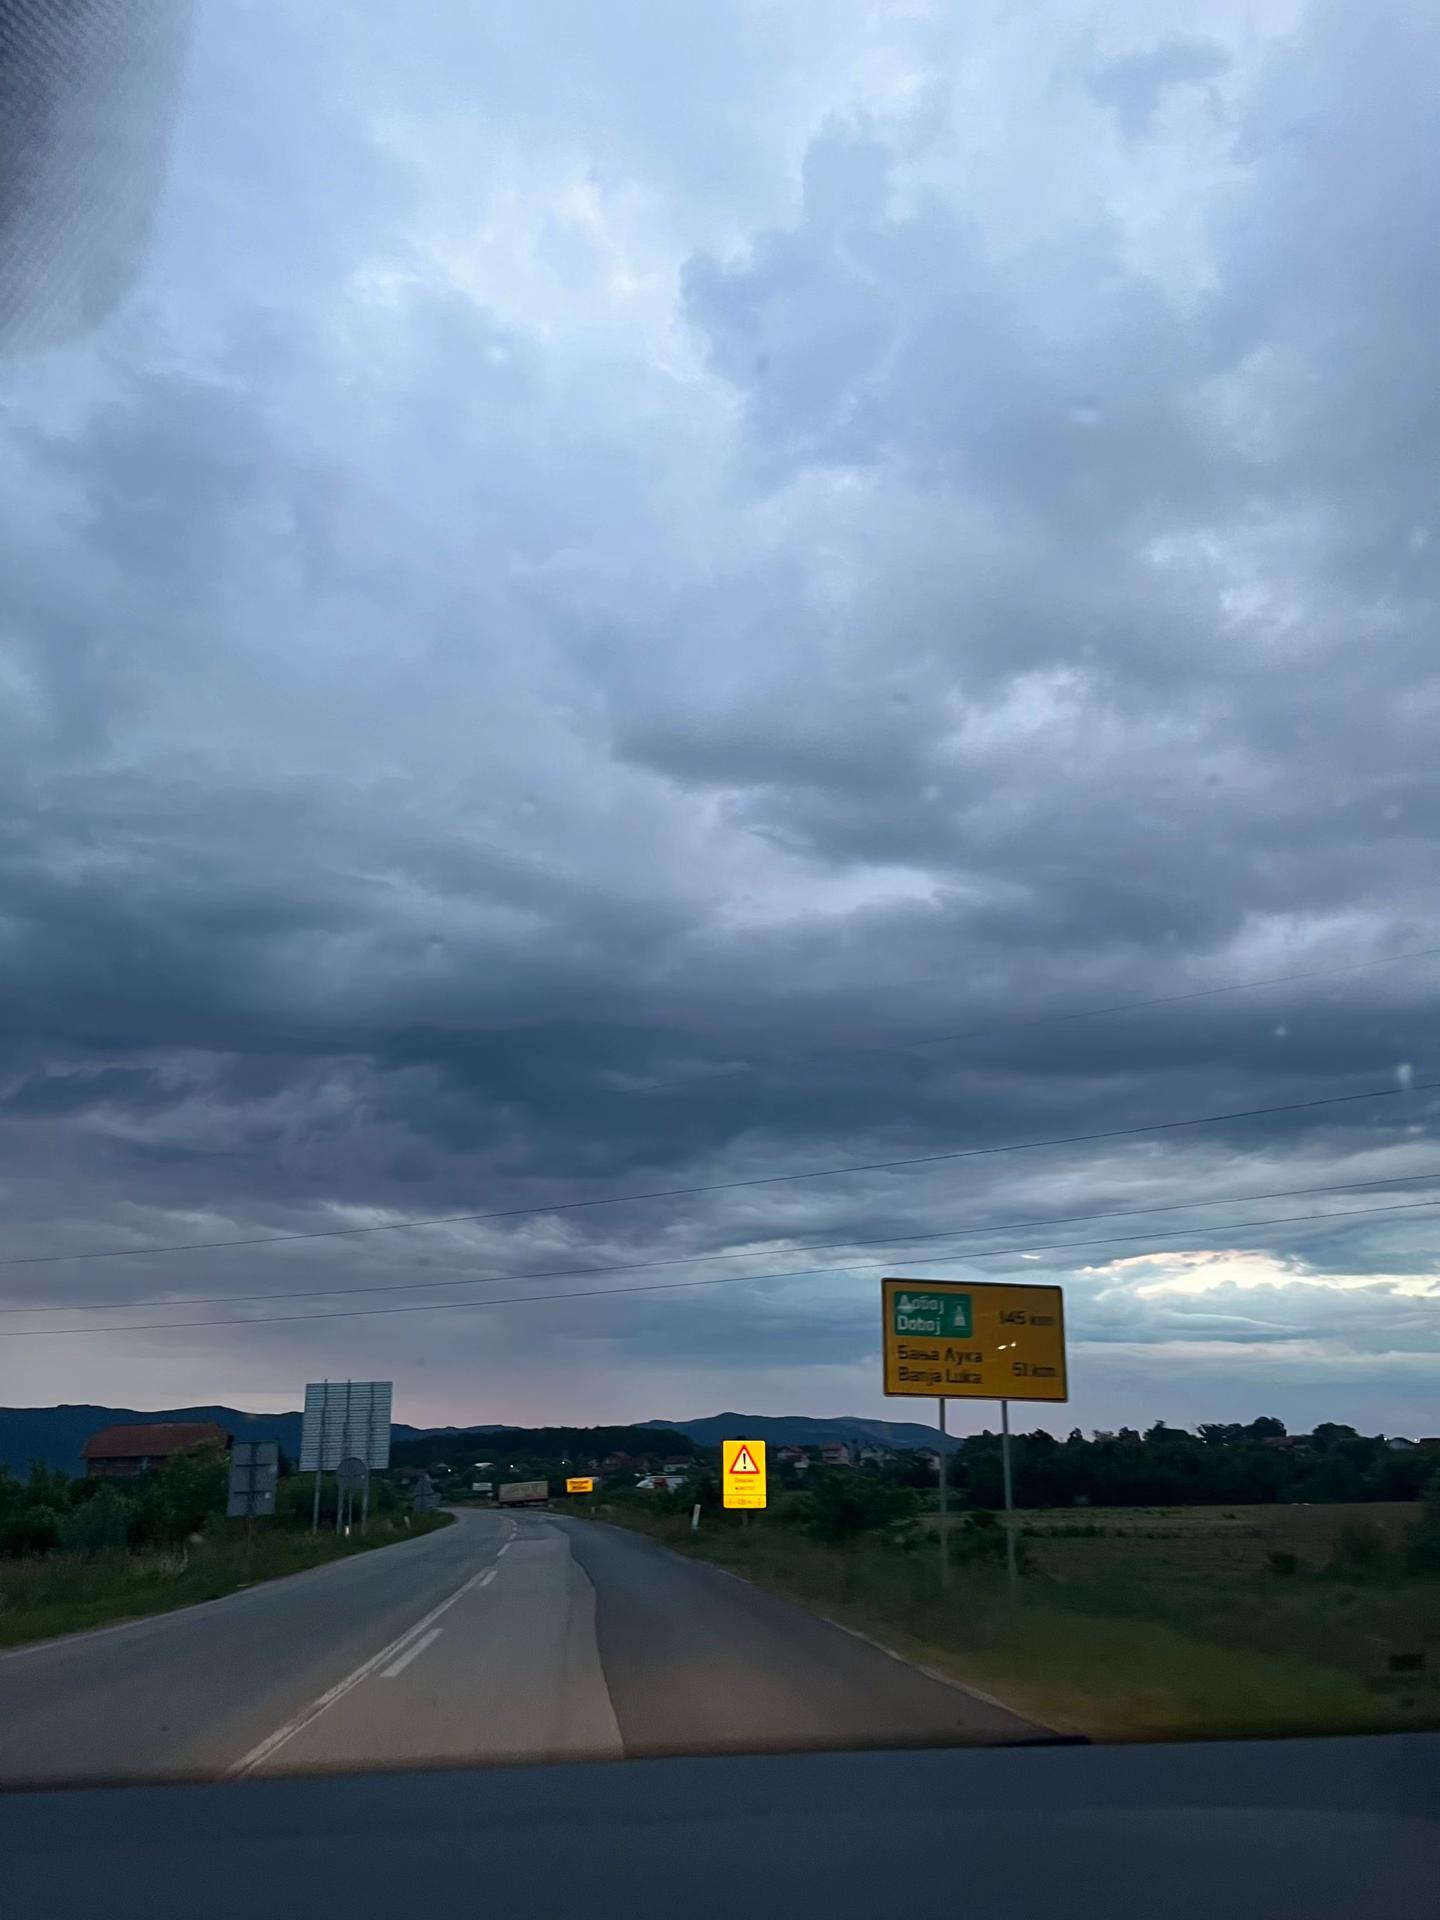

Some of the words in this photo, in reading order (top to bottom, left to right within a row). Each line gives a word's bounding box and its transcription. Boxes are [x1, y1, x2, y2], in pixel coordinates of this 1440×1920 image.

[897, 1315, 941, 1335] Doboj
[1000, 1310, 1025, 1325] 145
[1030, 1313, 1057, 1326] km
[898, 1366, 942, 1387] Banja
[945, 1368, 983, 1384] Luka
[1012, 1361, 1028, 1377] 51
[1032, 1364, 1057, 1378] km
